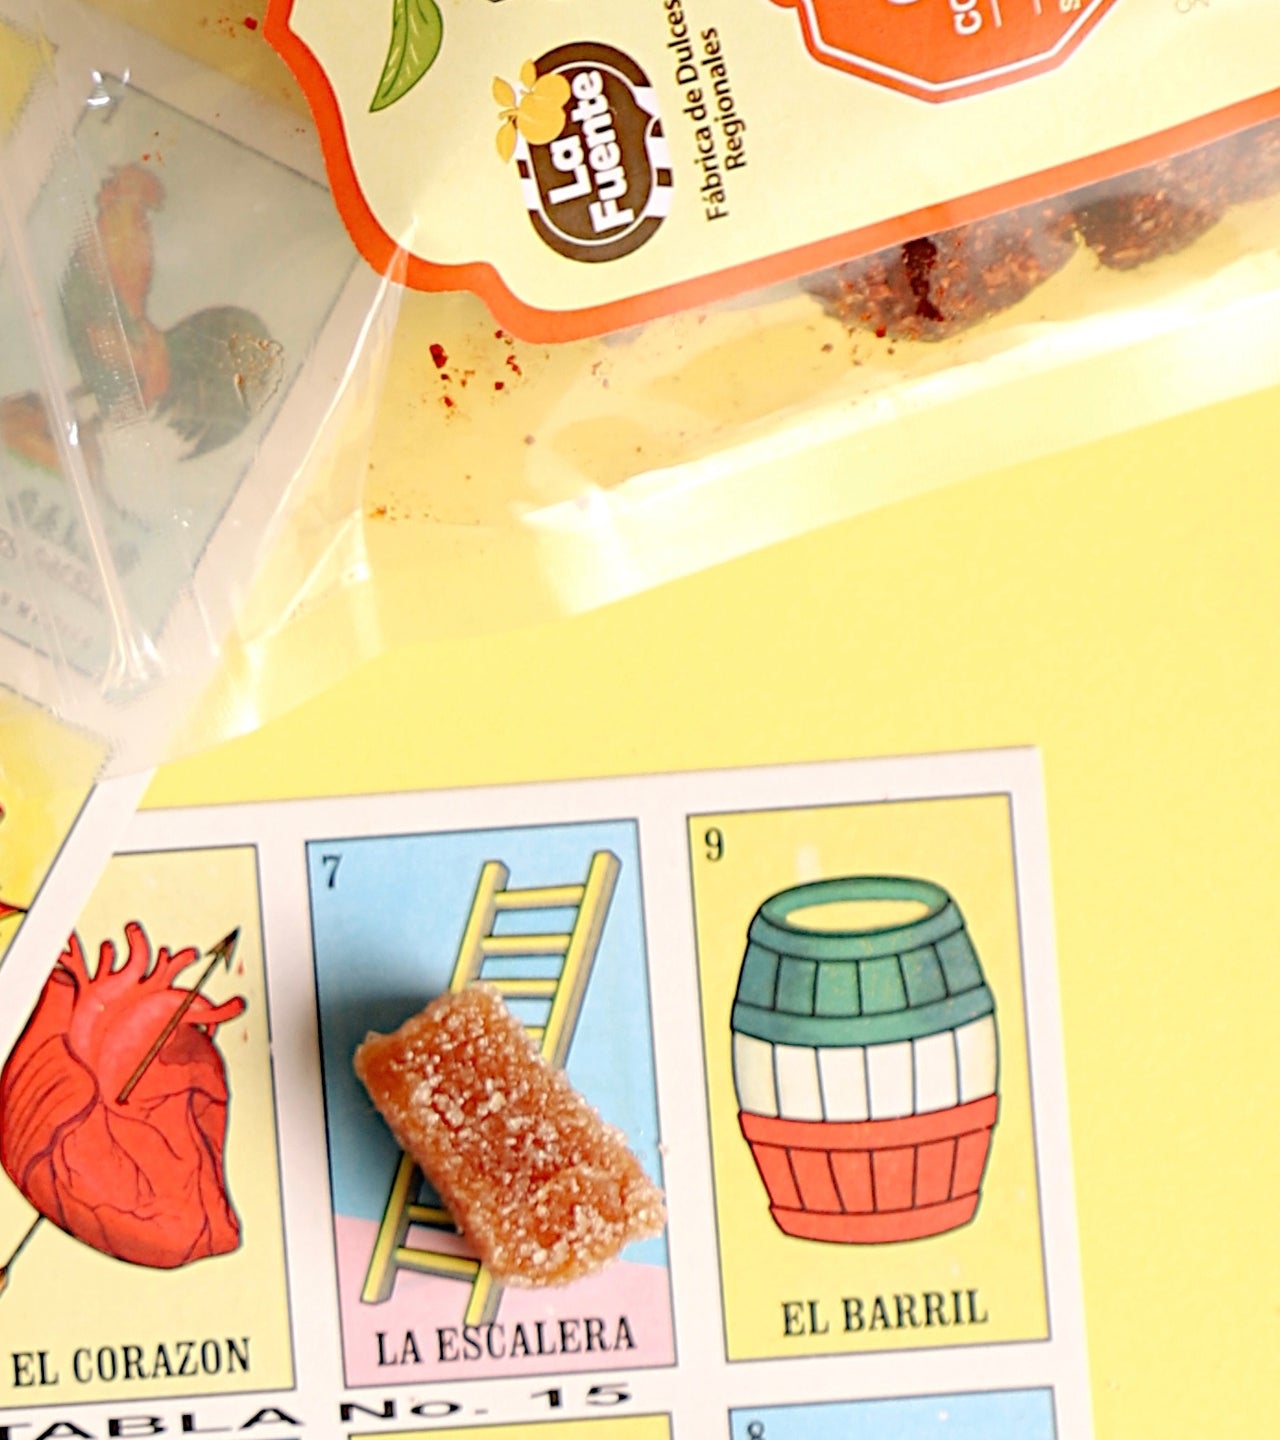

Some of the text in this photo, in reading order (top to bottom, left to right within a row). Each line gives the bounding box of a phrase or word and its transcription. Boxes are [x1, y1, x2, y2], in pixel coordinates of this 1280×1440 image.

[684, 88, 706, 122] de
[701, 27, 746, 171] Regionales
[548, 136, 592, 206] La
[572, 69, 634, 234] Fuente
[694, 131, 728, 222] Fábrica
[705, 828, 725, 861] 9
[322, 856, 341, 889] 7
[783, 1289, 989, 1337] EL BARRIL
[11, 1339, 251, 1388] EL CORAZON
[376, 1315, 639, 1367] LA ESCALERA
[529, 1385, 631, 1408] 15
